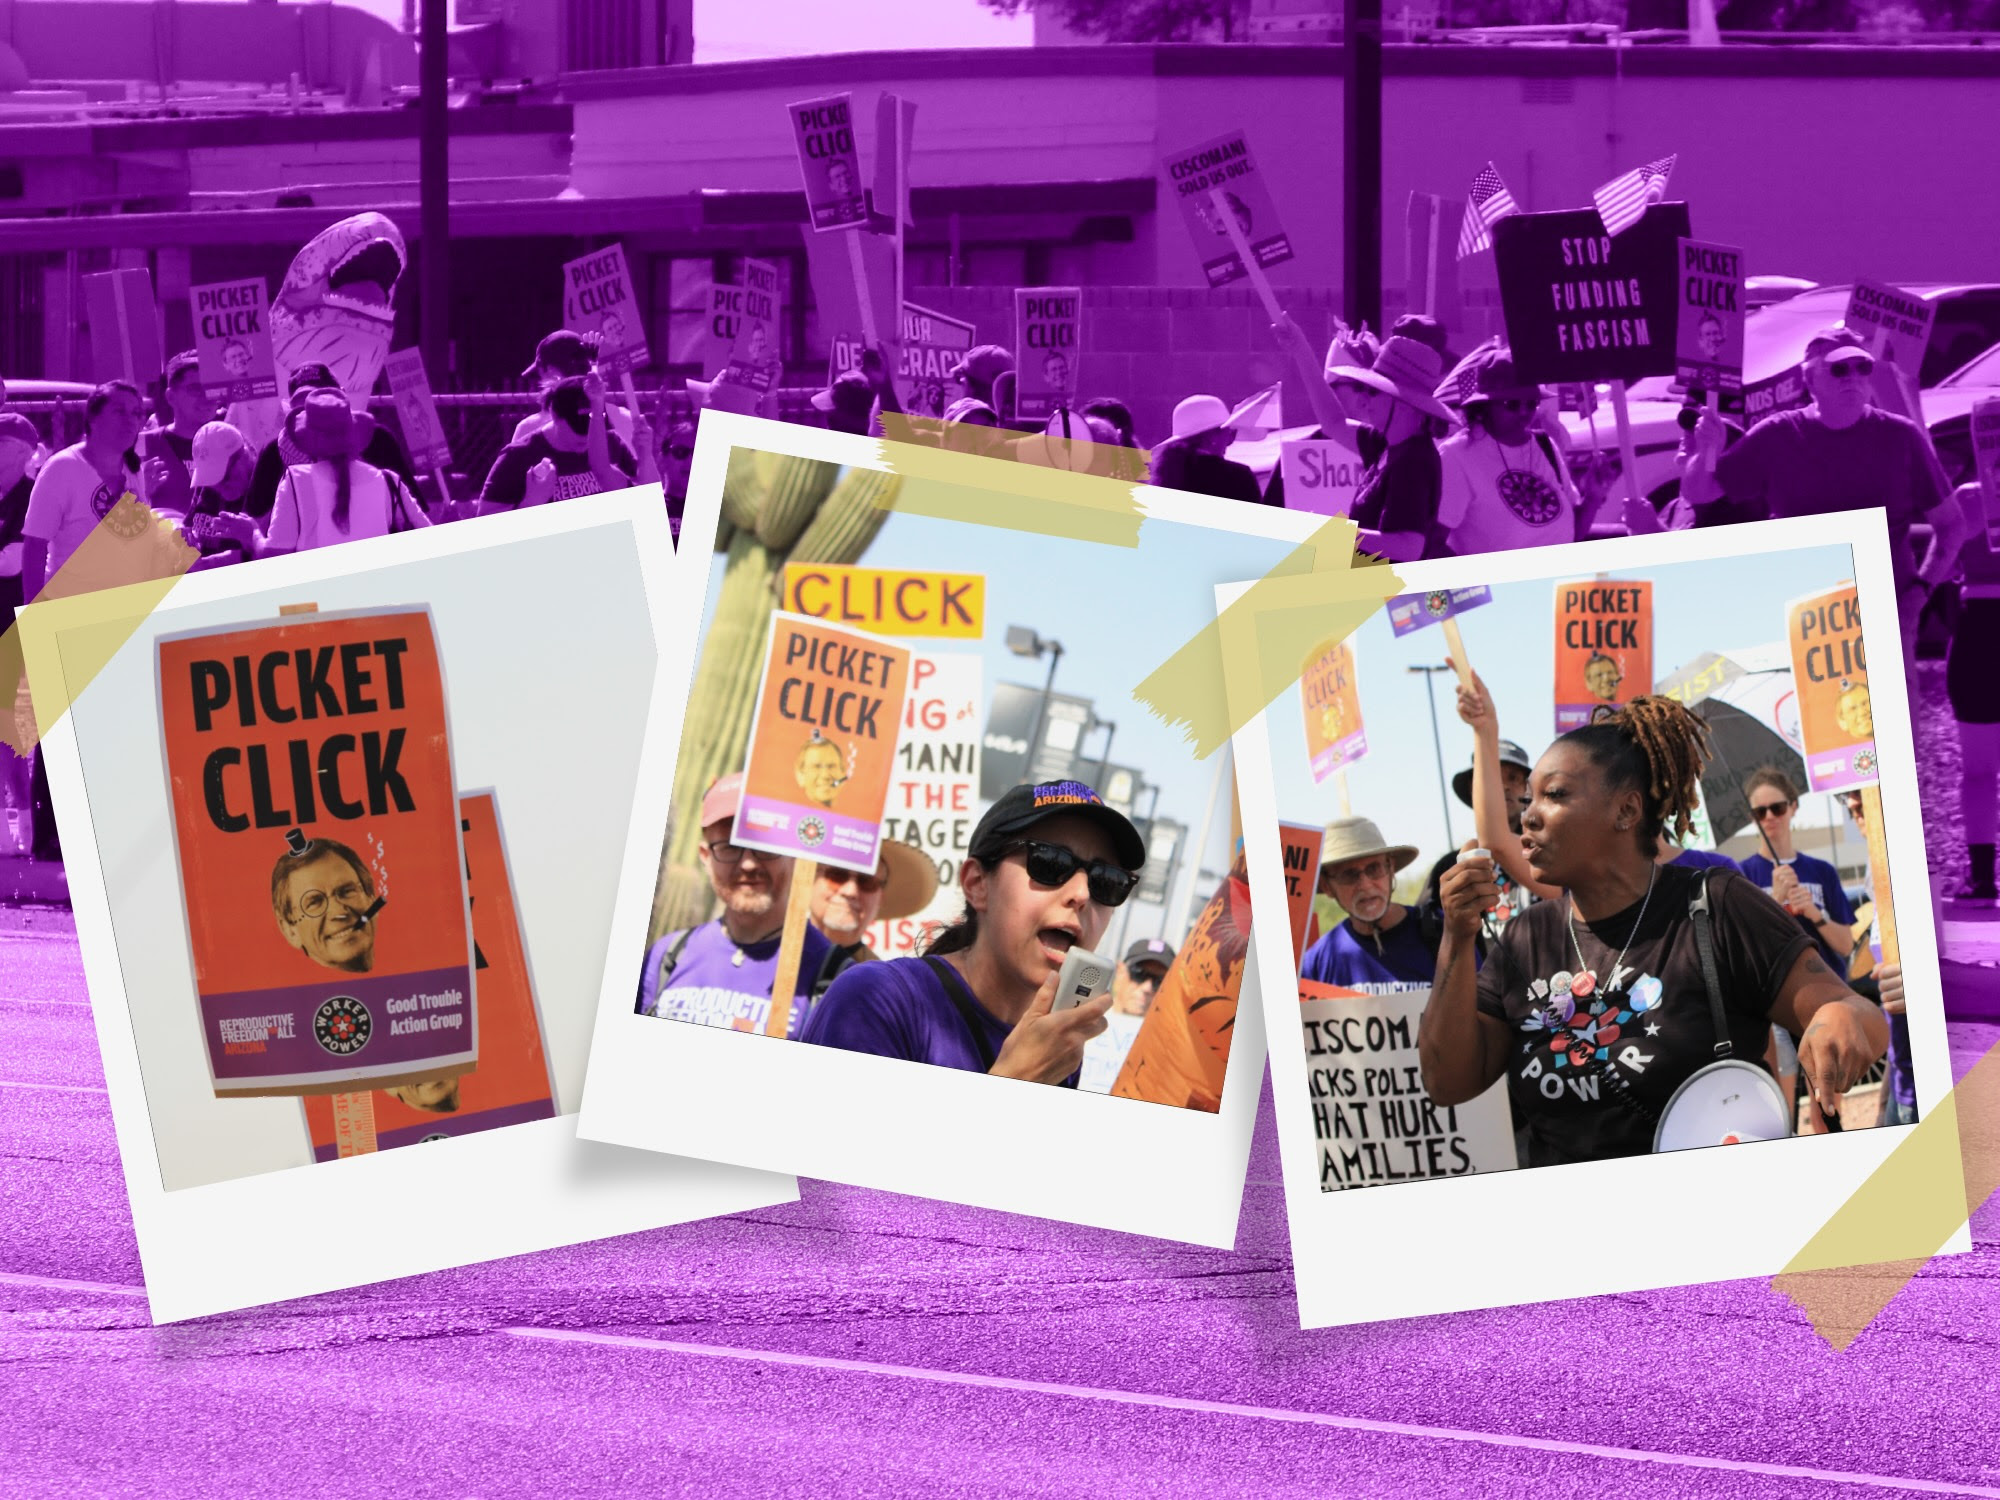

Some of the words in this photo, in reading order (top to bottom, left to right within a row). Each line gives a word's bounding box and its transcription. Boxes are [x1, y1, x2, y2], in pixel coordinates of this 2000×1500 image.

[1170, 138, 1247, 180] CISCOMANI
[1178, 174, 1209, 197] SOLD
[1208, 164, 1228, 185] US
[1226, 157, 1255, 180] OUT.
[1561, 236, 1612, 266] STOP
[1684, 245, 1739, 279] PICKET
[570, 252, 621, 289] PICKET
[747, 264, 775, 293] PICKET
[198, 284, 259, 312] PICKET
[578, 277, 627, 316] CLICK
[746, 290, 773, 322] CLICK
[1025, 297, 1075, 320] PICKET
[1551, 278, 1641, 311] FUNDING
[1685, 276, 1738, 312] CLICK
[1855, 284, 1931, 323] CISCOMANI
[201, 309, 261, 340] CLICK
[1026, 322, 1074, 349] CLICK
[1557, 317, 1651, 352] FASCISM
[1850, 303, 1880, 324] SOLD
[1881, 309, 1898, 329] US
[1898, 317, 1924, 341] OUT.
[555, 471, 596, 488] PRODU
[793, 573, 974, 627] CLICK
[1565, 588, 1642, 614] PICKET
[1565, 619, 1639, 649] CLICK
[1801, 595, 1861, 641] PICK
[785, 631, 895, 689] PICKET
[190, 638, 408, 732] PICKET
[1306, 664, 1347, 711] CLICK
[778, 677, 883, 739] CLICK
[203, 727, 417, 834] CLICK
[899, 781, 971, 811] THE
[316, 999, 368, 1028] WORKER
[386, 993, 418, 1015] Good
[418, 988, 463, 1010] Trouble
[219, 1013, 295, 1032] REPRODUCTIVE
[221, 1029, 269, 1044] FREEDOM
[277, 1025, 297, 1040] ALL
[390, 1015, 429, 1036] Action
[429, 1012, 463, 1030] Group
[1304, 1014, 1424, 1056] ISCOM
[224, 1039, 268, 1056] ARIZONA
[322, 1031, 368, 1053] POWER
[1365, 1066, 1426, 1097] POLI
